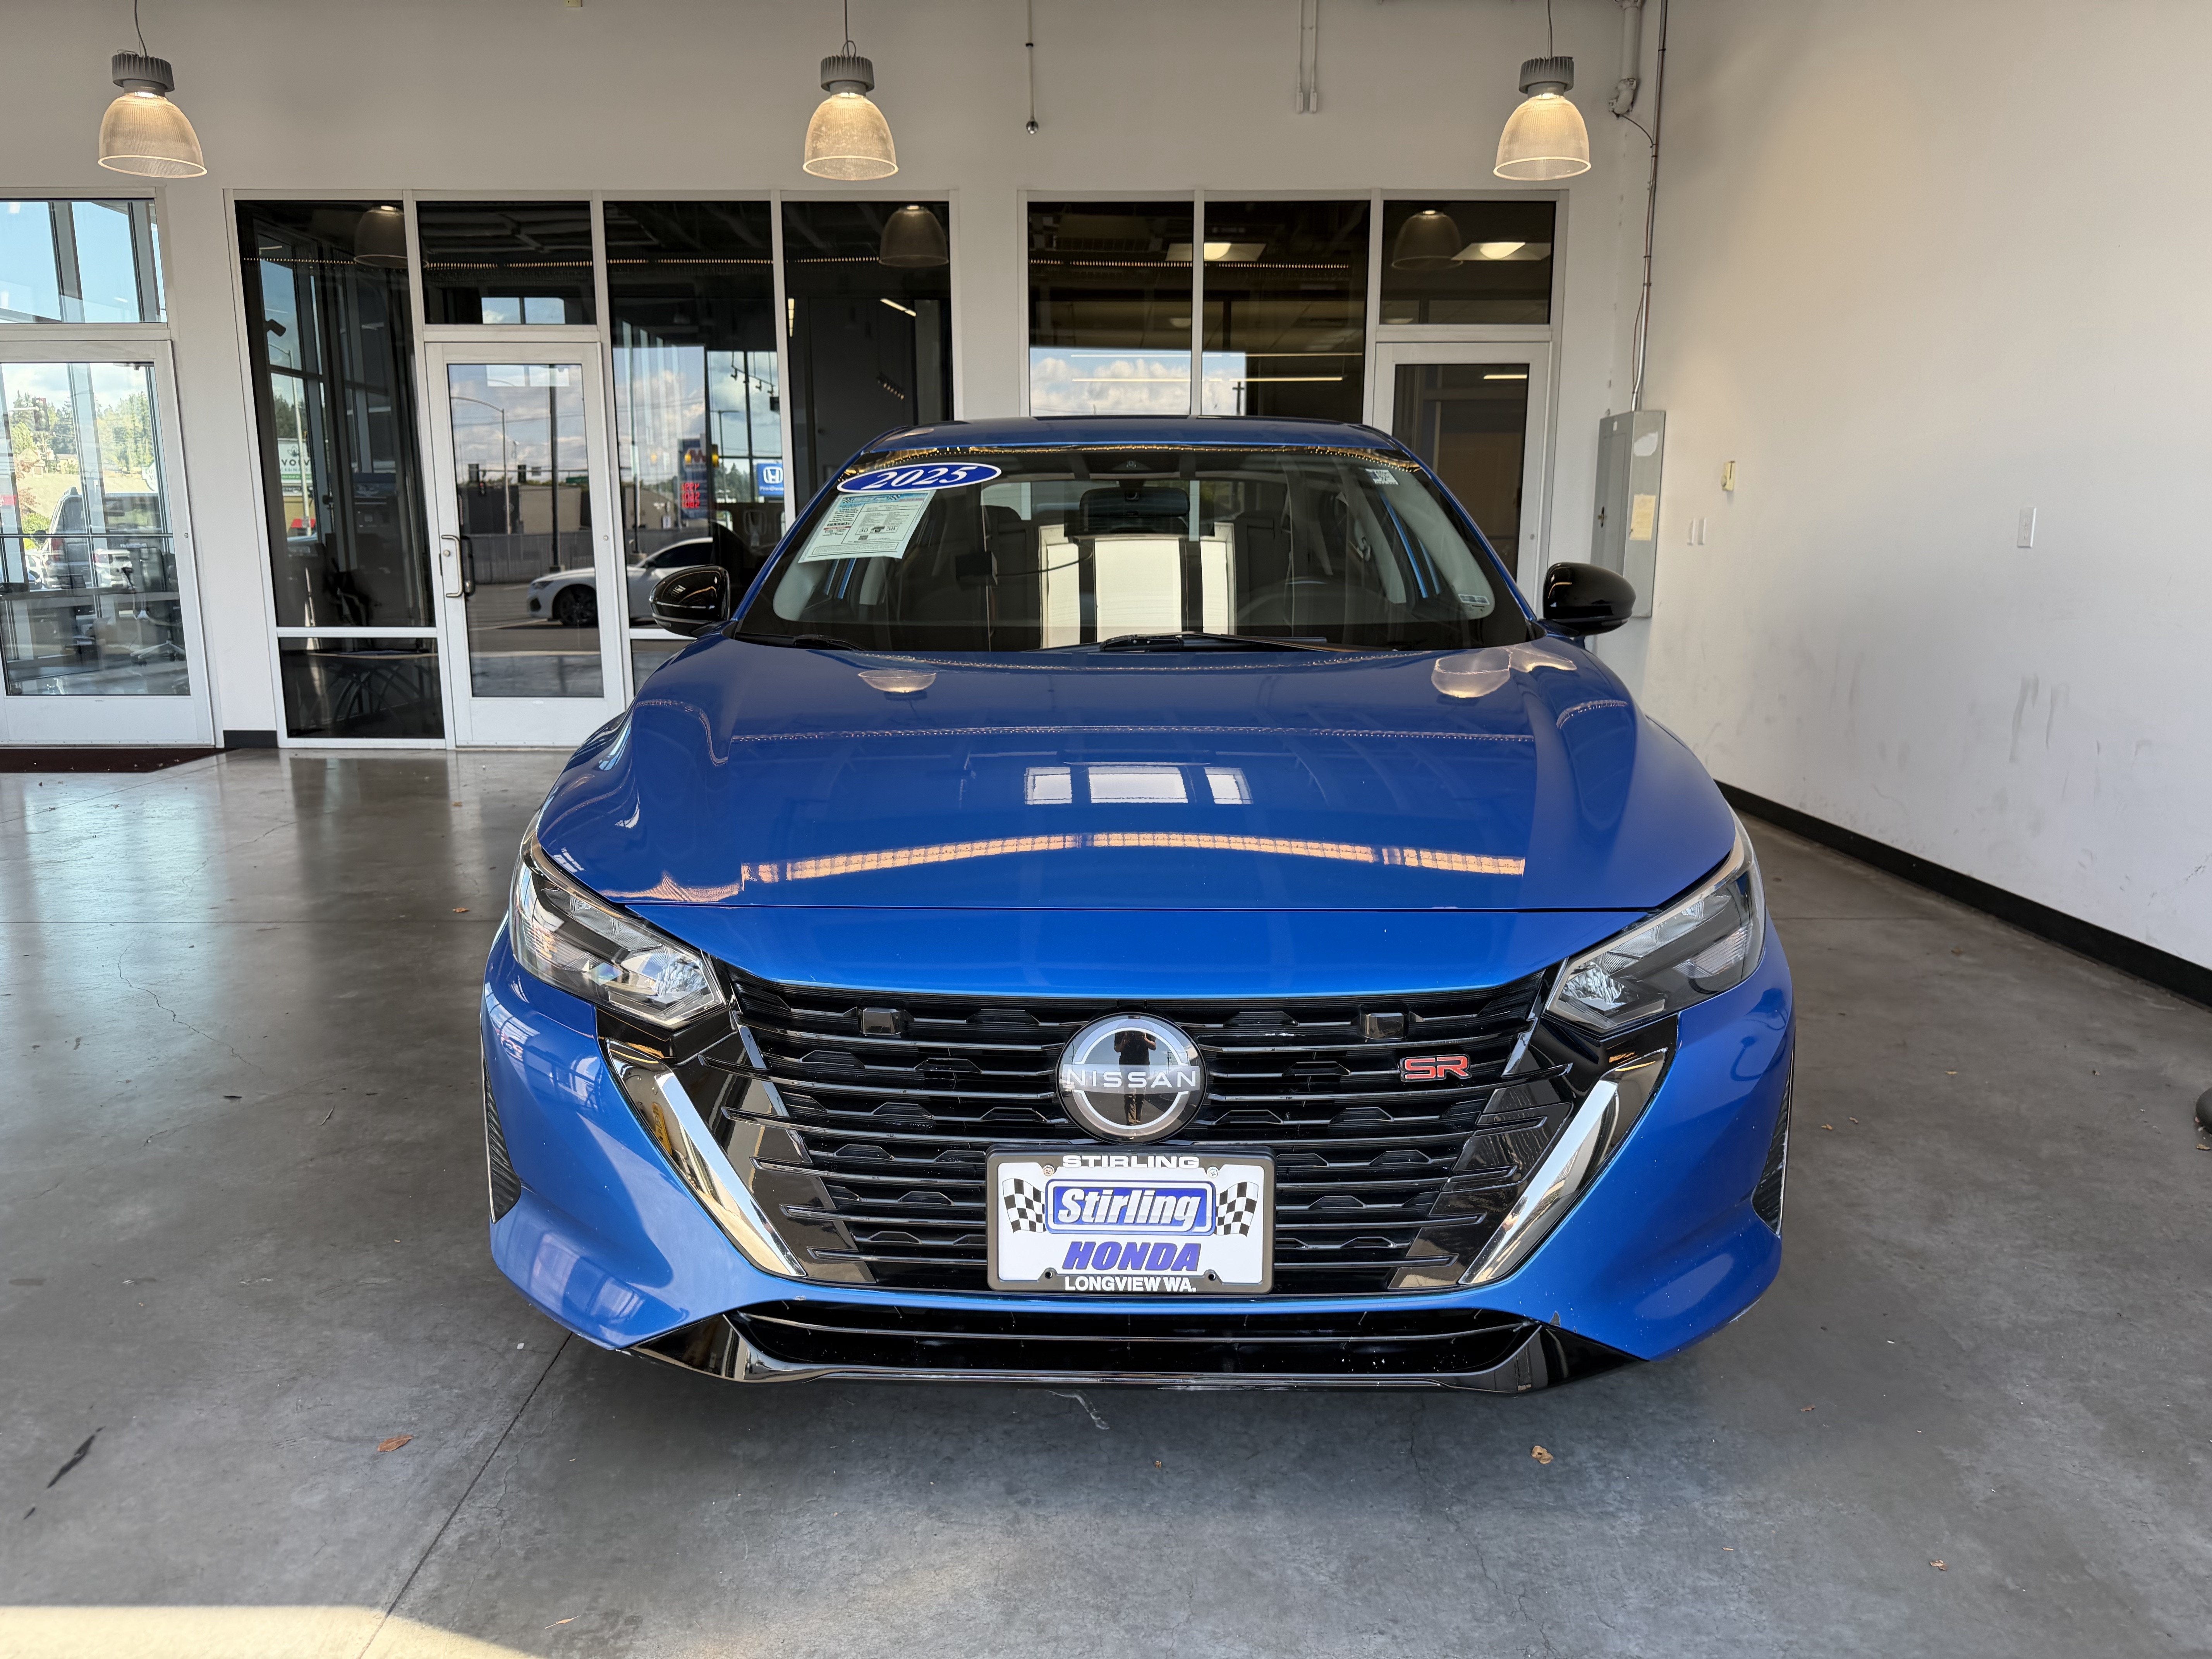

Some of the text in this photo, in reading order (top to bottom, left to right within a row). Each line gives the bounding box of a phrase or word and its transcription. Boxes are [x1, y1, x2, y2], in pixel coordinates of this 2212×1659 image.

[860, 466, 978, 490] 2025
[1067, 1068, 1196, 1088] NISSAN
[1404, 1056, 1469, 1079] SR
[1062, 1154, 1200, 1169] STIRLING
[1058, 1188, 1202, 1232] Stirling
[1061, 1241, 1202, 1271] HONDA
[1065, 1276, 1197, 1292] LONGVIEW WA.
